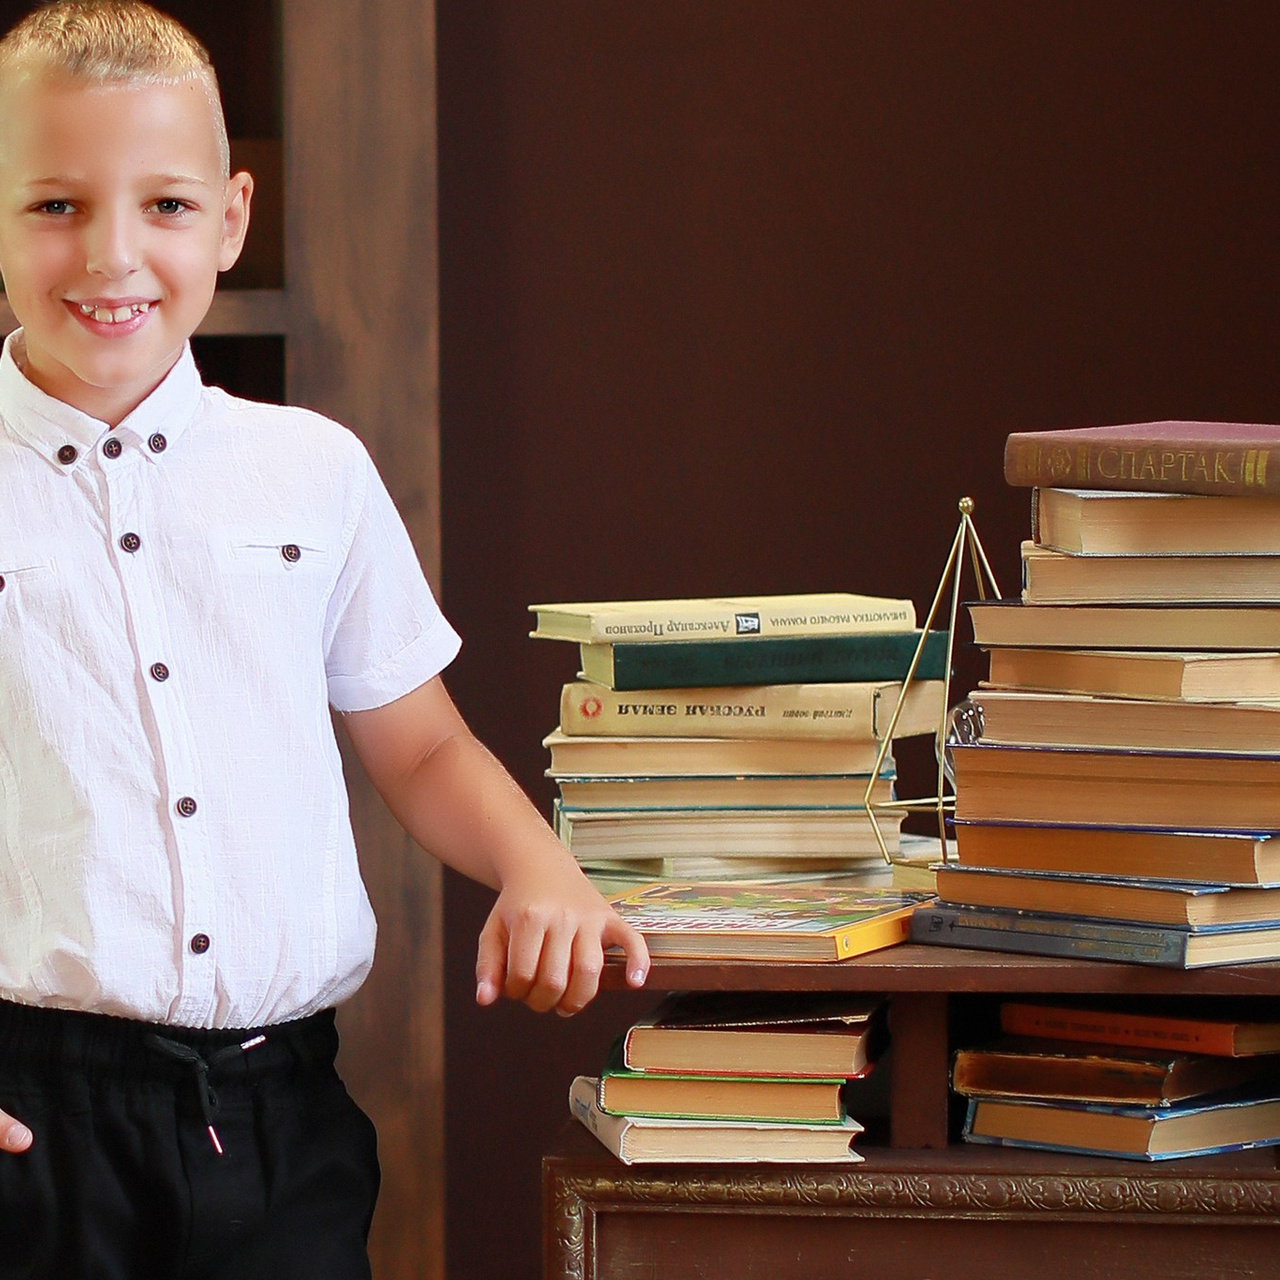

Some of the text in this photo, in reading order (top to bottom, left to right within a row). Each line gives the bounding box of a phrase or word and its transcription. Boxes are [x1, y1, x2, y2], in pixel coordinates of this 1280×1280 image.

[1097, 446, 1235, 484] СПАРТАК
[770, 611, 907, 627] БИБЛИОТЕКА РАБОЧЕГО РОМАНА
[605, 620, 730, 636] Александр Проханов
[617, 704, 766, 717] РУССКАЯ ЗЕМЛЯ
